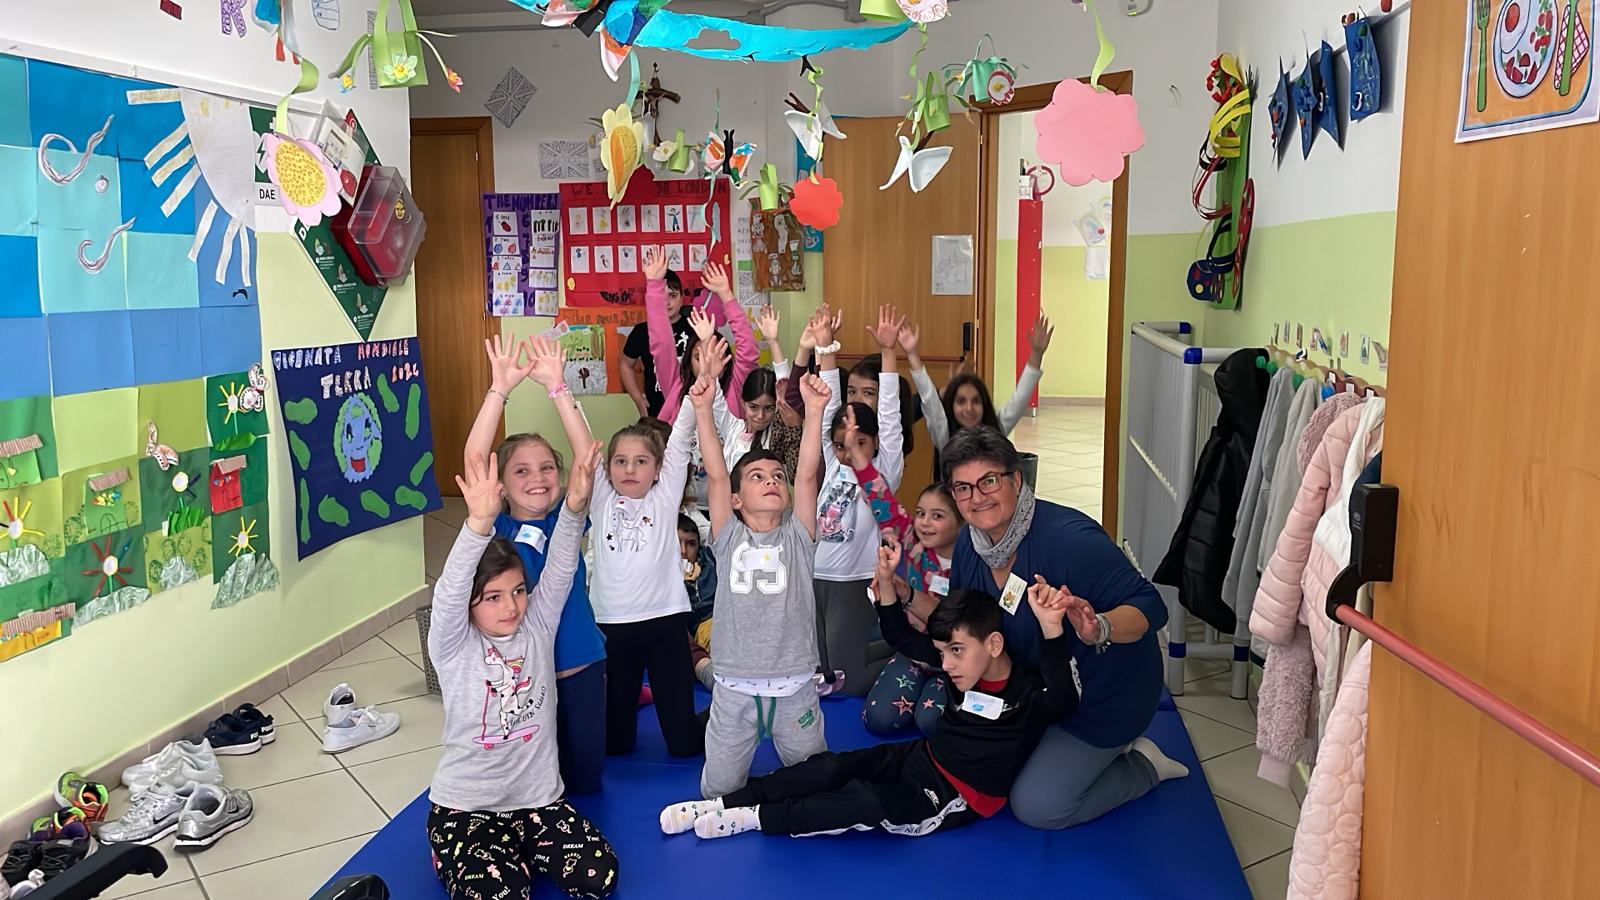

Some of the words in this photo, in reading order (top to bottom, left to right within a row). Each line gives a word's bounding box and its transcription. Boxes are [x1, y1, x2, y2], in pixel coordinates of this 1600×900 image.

[259, 188, 276, 200] DAE
[483, 194, 510, 210] THE
[321, 366, 372, 399] TERRA
[464, 872, 485, 881] DREAM
